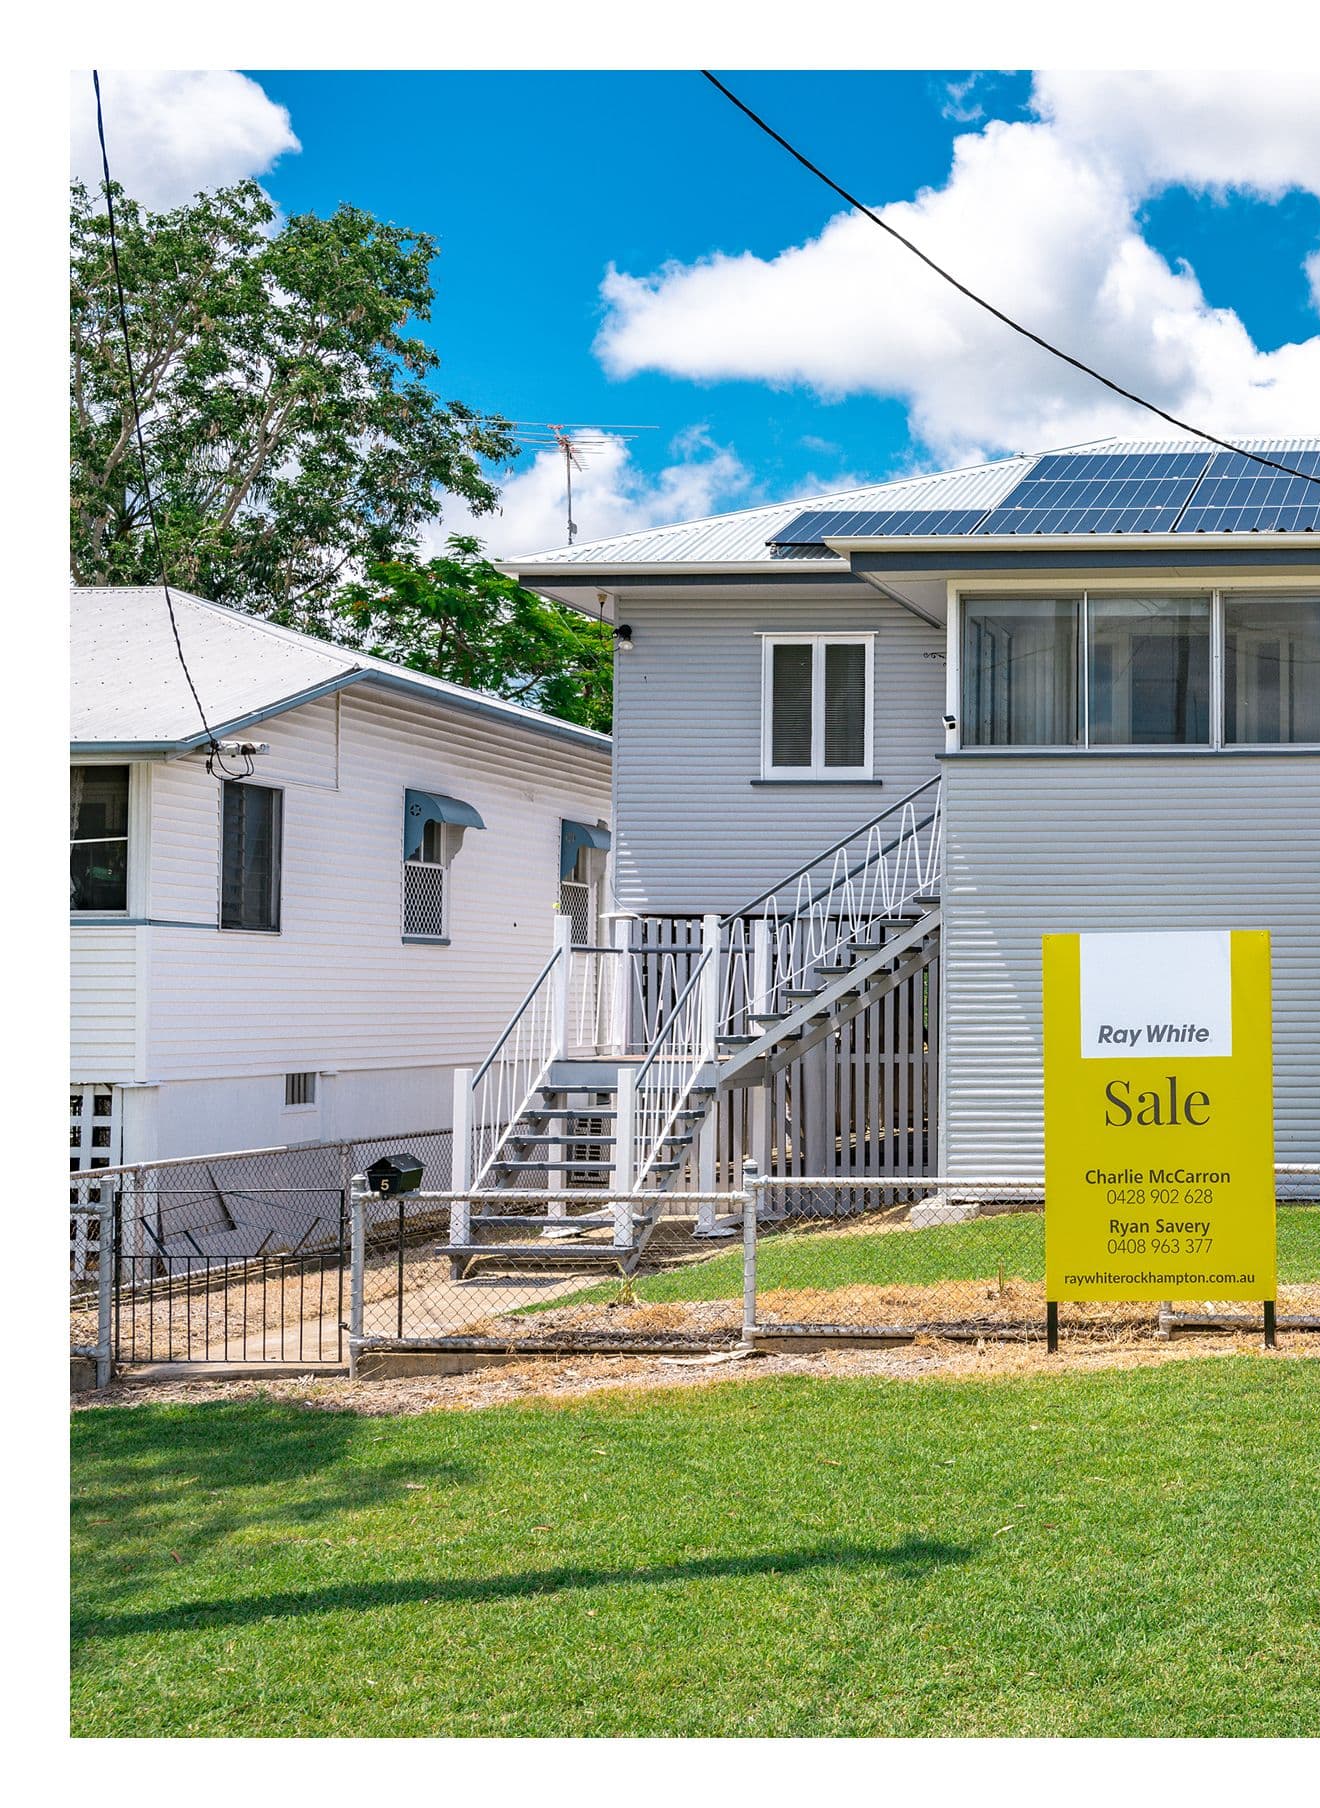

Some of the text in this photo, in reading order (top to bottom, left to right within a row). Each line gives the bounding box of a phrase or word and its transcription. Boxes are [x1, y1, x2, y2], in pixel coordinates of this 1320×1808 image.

[1098, 1024, 1210, 1047] Ray White
[1105, 1076, 1211, 1127] Sale
[380, 1178, 390, 1191] 5
[1085, 1168, 1231, 1185] Charlie McCarron
[1107, 1188, 1213, 1205] 0428 902 628
[1109, 1218, 1211, 1238] Ryan Savery
[1107, 1238, 1213, 1255] 0408 963 377
[1064, 1271, 1255, 1287] raywhiterockhampton.com.au
